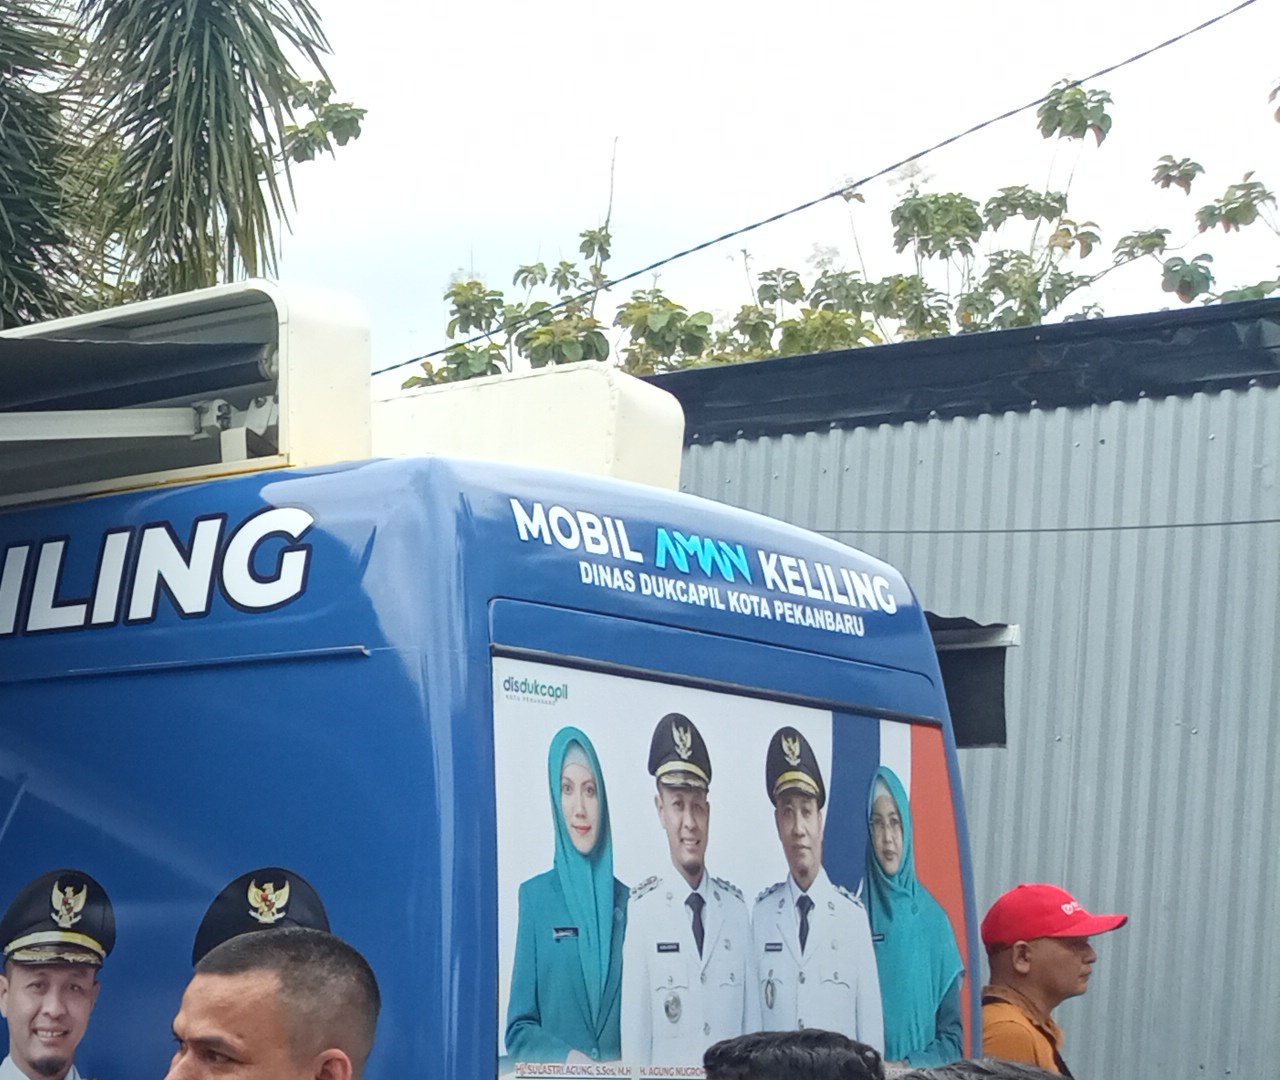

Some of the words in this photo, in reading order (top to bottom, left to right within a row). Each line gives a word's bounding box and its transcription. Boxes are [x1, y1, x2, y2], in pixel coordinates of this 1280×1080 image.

[509, 498, 644, 563] MOBIL
[757, 549, 898, 614] KELILING
[579, 561, 636, 593] DINAS
[639, 573, 726, 611] DUKCAPIL
[729, 593, 772, 619] KOTA
[775, 601, 865, 637] PEKANBARU
[503, 676, 569, 702] disdukcapil
